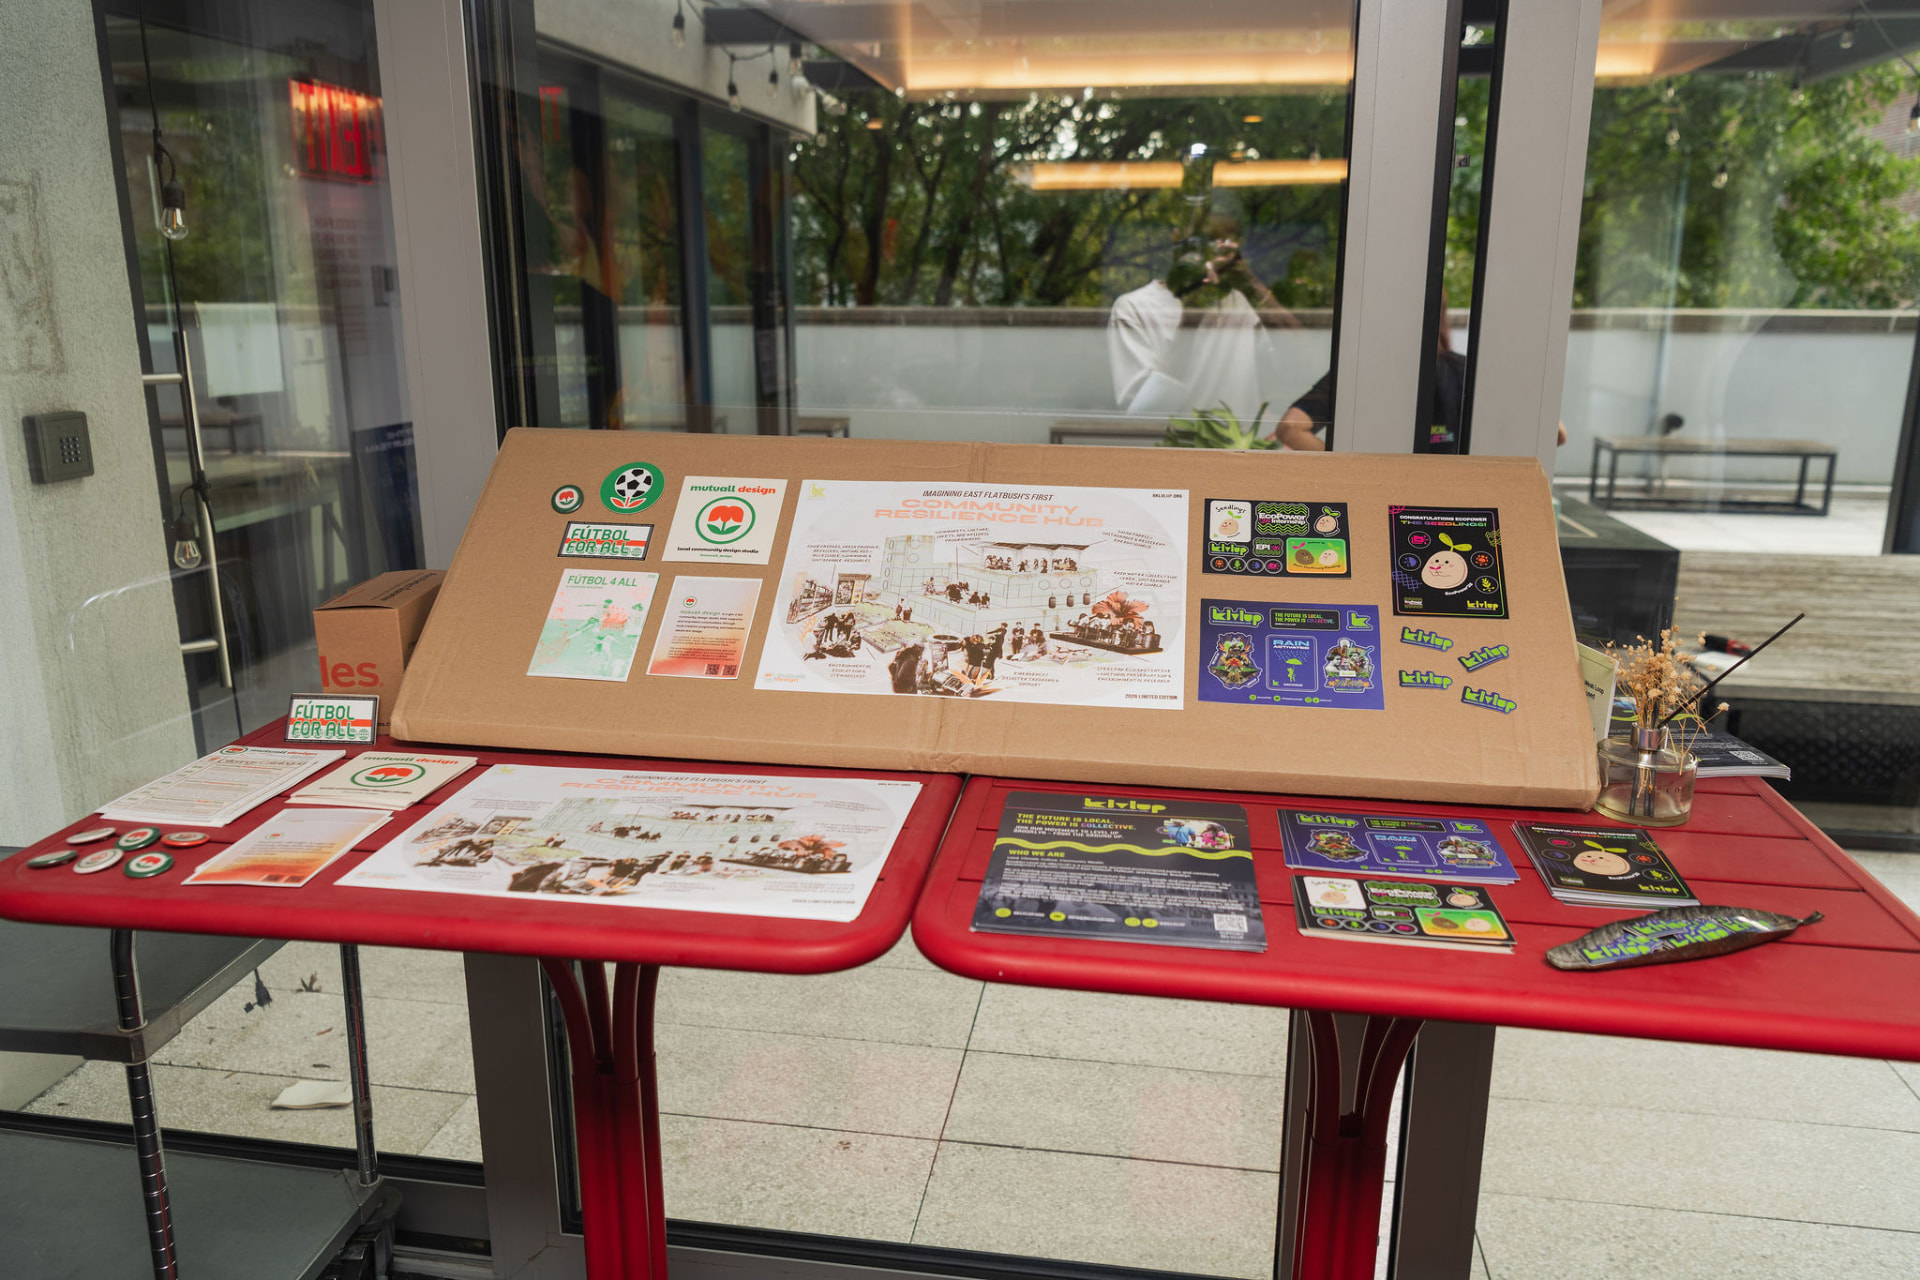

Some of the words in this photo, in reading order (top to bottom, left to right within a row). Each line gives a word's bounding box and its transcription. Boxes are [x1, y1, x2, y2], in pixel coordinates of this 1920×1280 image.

[690, 485, 736, 493] mutuall
[737, 485, 776, 496] design
[922, 490, 962, 498] IMAGINING
[984, 491, 1030, 500] FLATBUSH'S
[1031, 493, 1054, 501] FIRST
[902, 499, 1079, 515] COMMUNITY
[1215, 504, 1247, 514] Seedlings
[874, 509, 1038, 524] RESILIENCE
[1043, 515, 1104, 527] HUB
[1258, 512, 1307, 521] EcoPower
[1271, 518, 1306, 526] Internship
[571, 525, 630, 541] FÚTBOL
[566, 541, 596, 553] FOR
[600, 541, 629, 554] ALL
[567, 574, 607, 586] FÚTBOL
[610, 577, 616, 586] 4
[618, 578, 638, 587] ALL
[1272, 639, 1310, 647] RAIN
[319, 656, 380, 688] les
[294, 701, 355, 720] FÚTBOL
[291, 721, 321, 736] FOR
[325, 722, 354, 737] ALL
[561, 782, 744, 797] RESILIENCE
[749, 791, 818, 799] HUB
[595, 778, 793, 792] COMMUNITY
[1036, 814, 1071, 822] FUTURE
[1035, 819, 1067, 827] POWER
[1080, 822, 1137, 831] COLLECTIVE.
